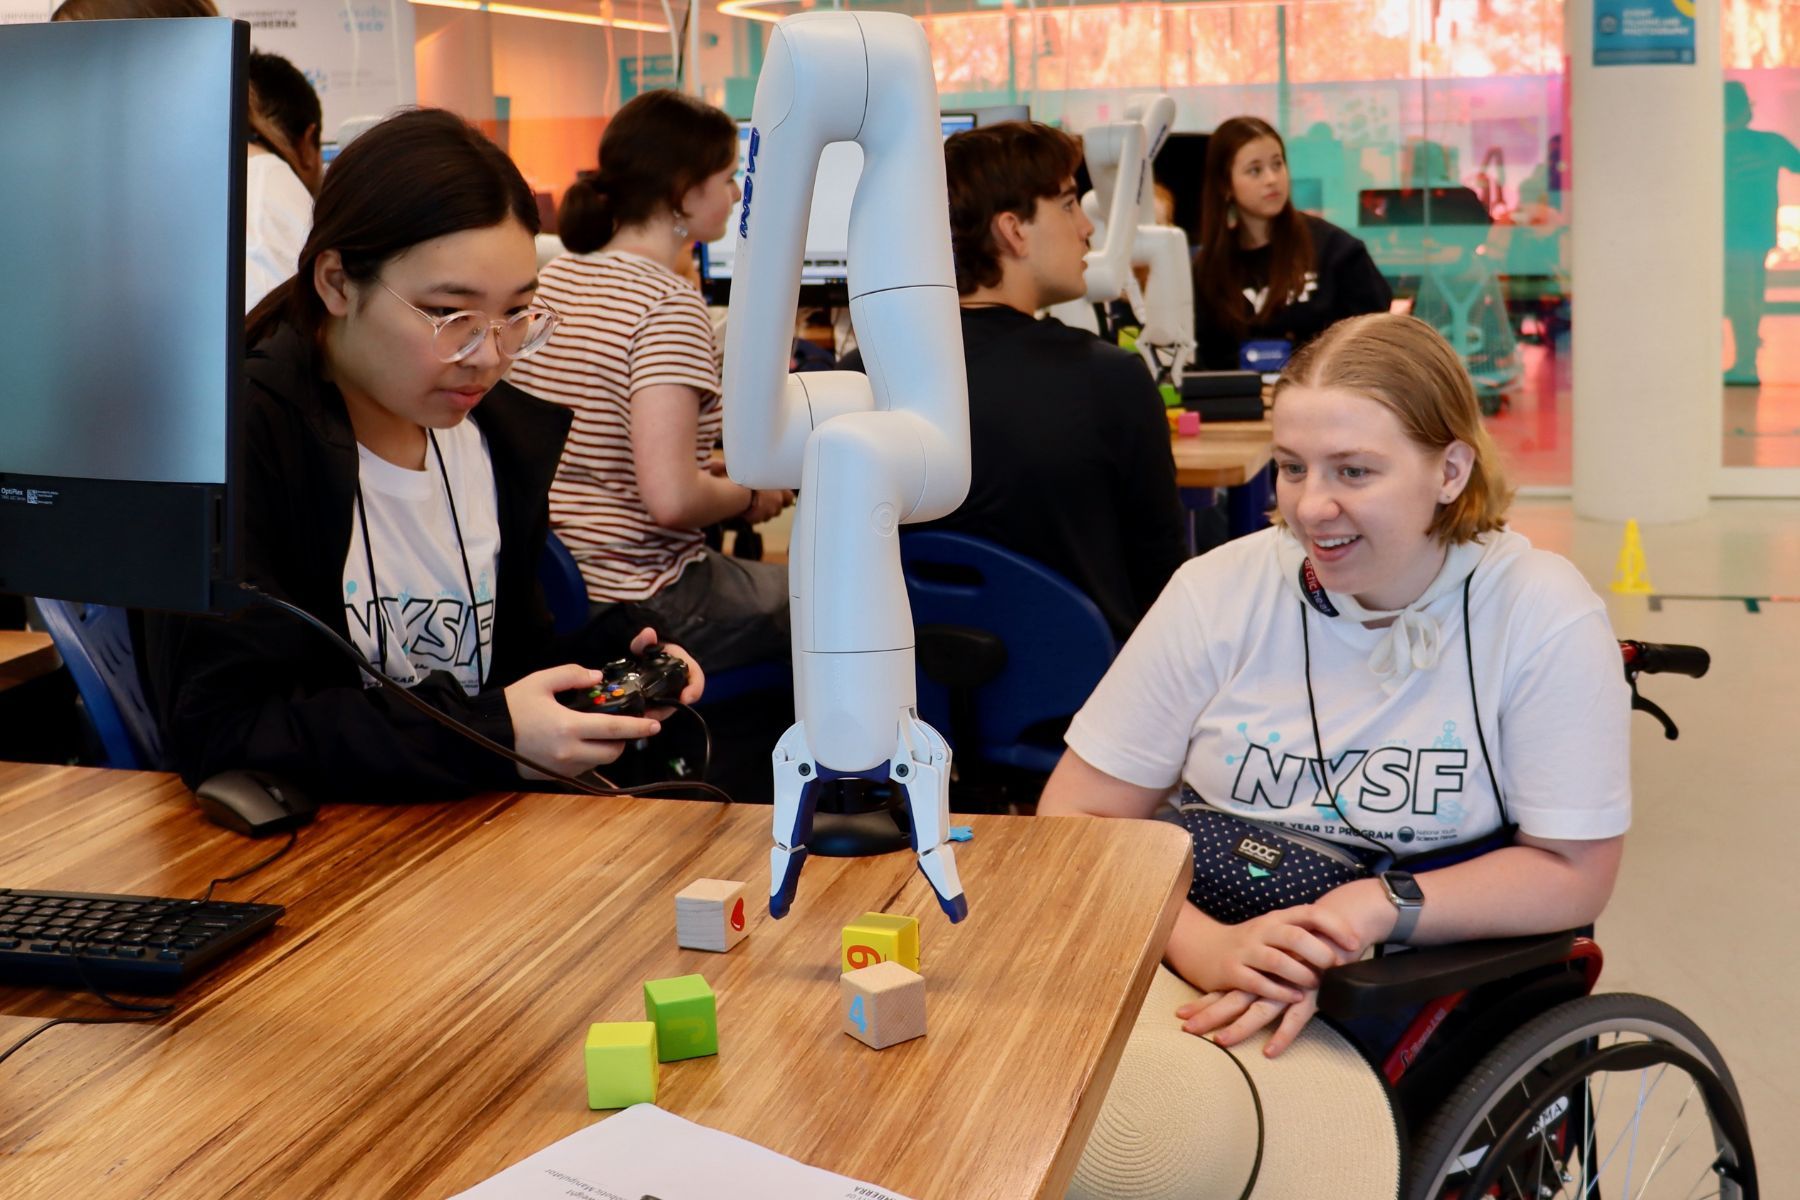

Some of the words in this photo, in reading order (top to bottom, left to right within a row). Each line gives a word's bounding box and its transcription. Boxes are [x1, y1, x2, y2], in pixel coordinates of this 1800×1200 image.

[1231, 742, 1468, 815] NYSF
[1324, 825, 1335, 834] 12
[1338, 826, 1394, 840] PROGRAM
[1240, 838, 1281, 861] DOOG
[848, 995, 867, 1034] 4
